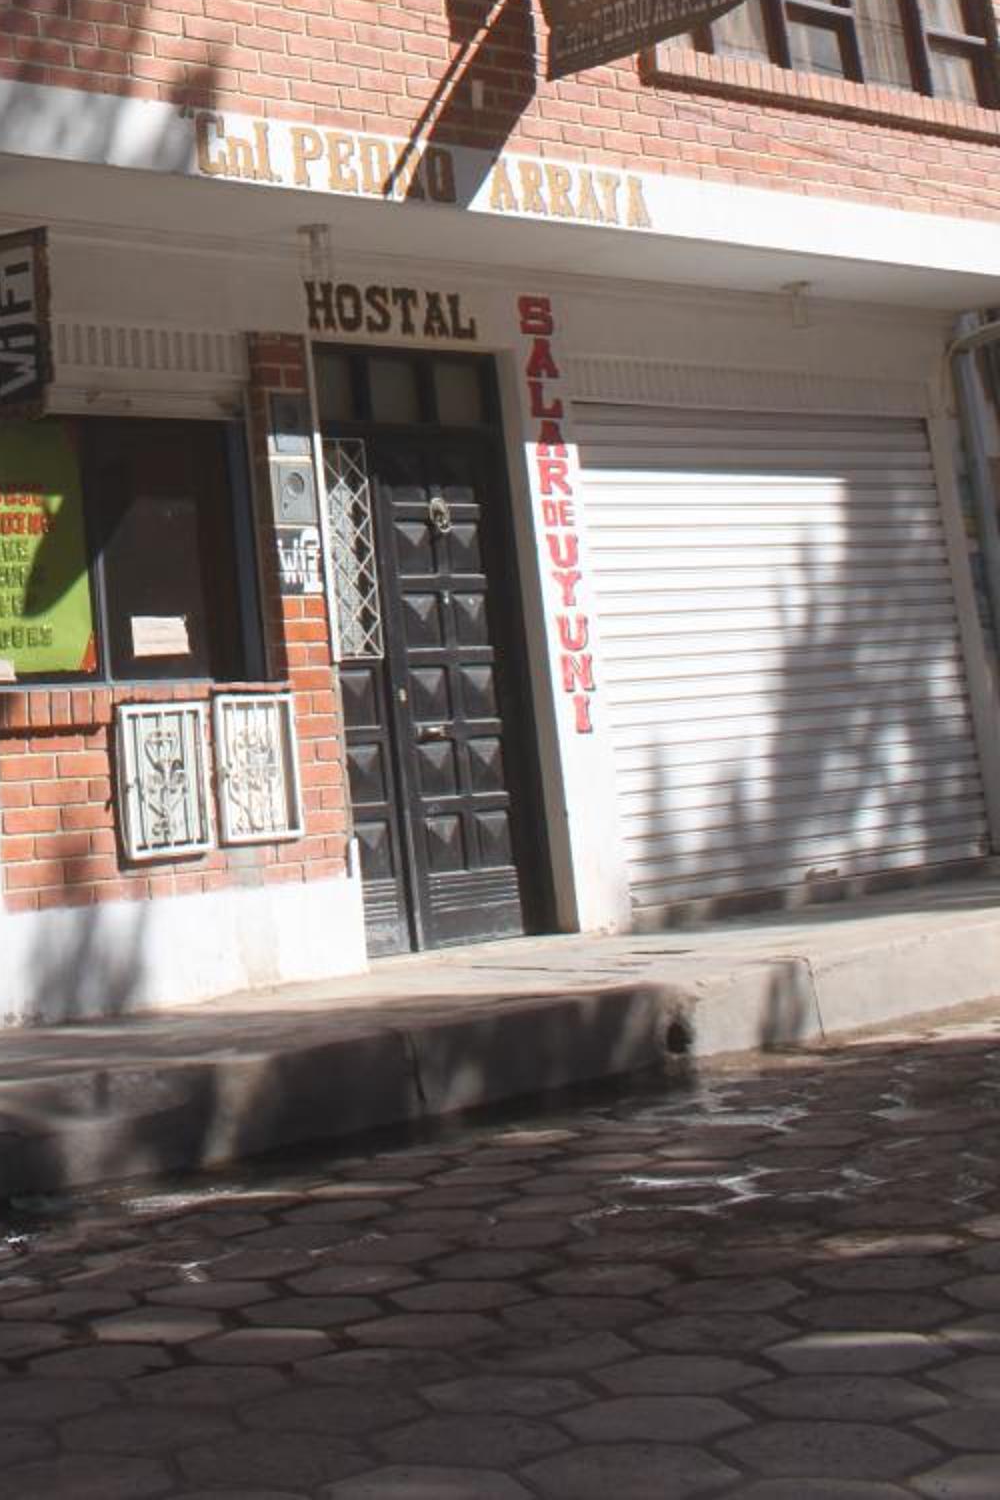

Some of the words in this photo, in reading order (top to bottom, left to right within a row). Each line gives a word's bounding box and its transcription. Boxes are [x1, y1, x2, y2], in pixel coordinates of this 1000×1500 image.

[290, 126, 458, 203] PEDRO
[304, 280, 477, 340] HOSTAL
[518, 296, 573, 496] SALAR
[542, 499, 574, 528] DE
[546, 533, 596, 734] UYUNI
